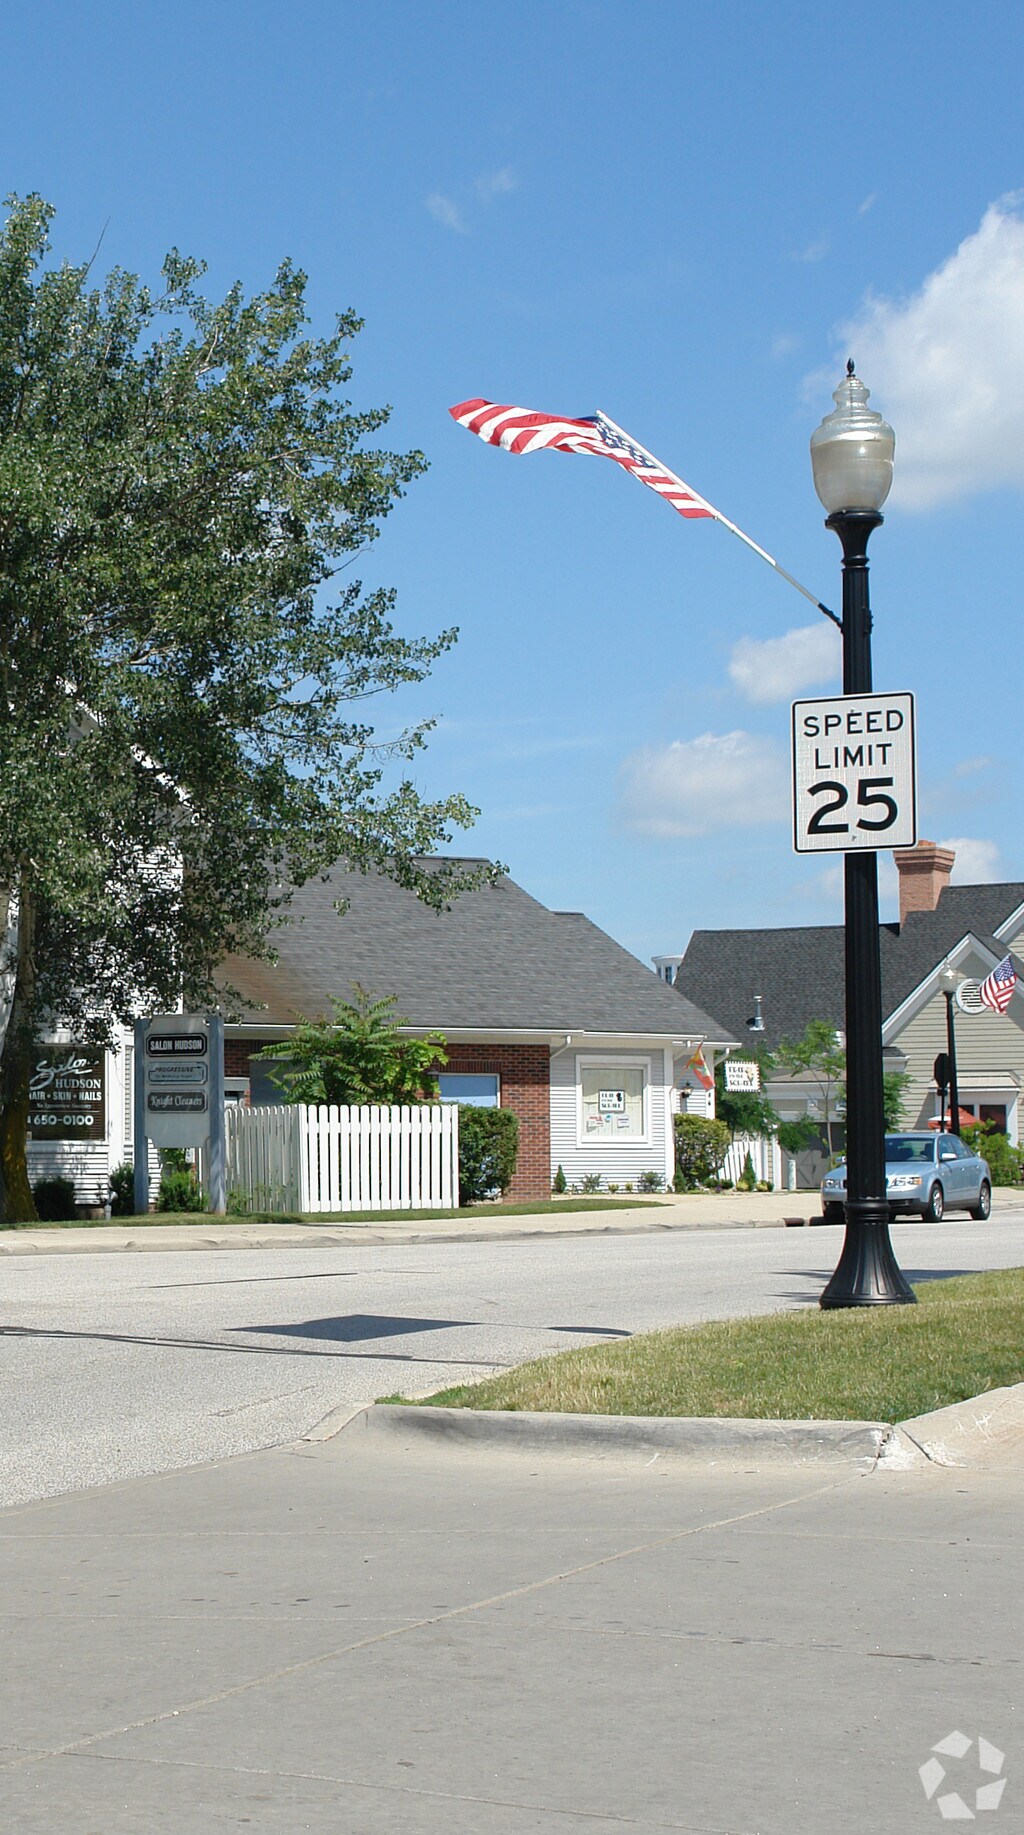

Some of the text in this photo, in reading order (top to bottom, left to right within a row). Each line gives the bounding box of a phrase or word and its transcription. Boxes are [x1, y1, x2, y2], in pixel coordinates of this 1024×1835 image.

[803, 709, 904, 738] SPEED
[814, 743, 892, 770] LIMIT
[806, 776, 899, 835] 25
[150, 1039, 202, 1051] SALON HUDSON
[29, 1051, 99, 1090] Salon
[55, 1079, 101, 1089] HUDSON
[53, 1091, 71, 1101] SKIN
[78, 1091, 102, 1101] NAILS
[151, 1095, 203, 1108] Knight Cleaners
[33, 1114, 94, 1126] 650-0100
